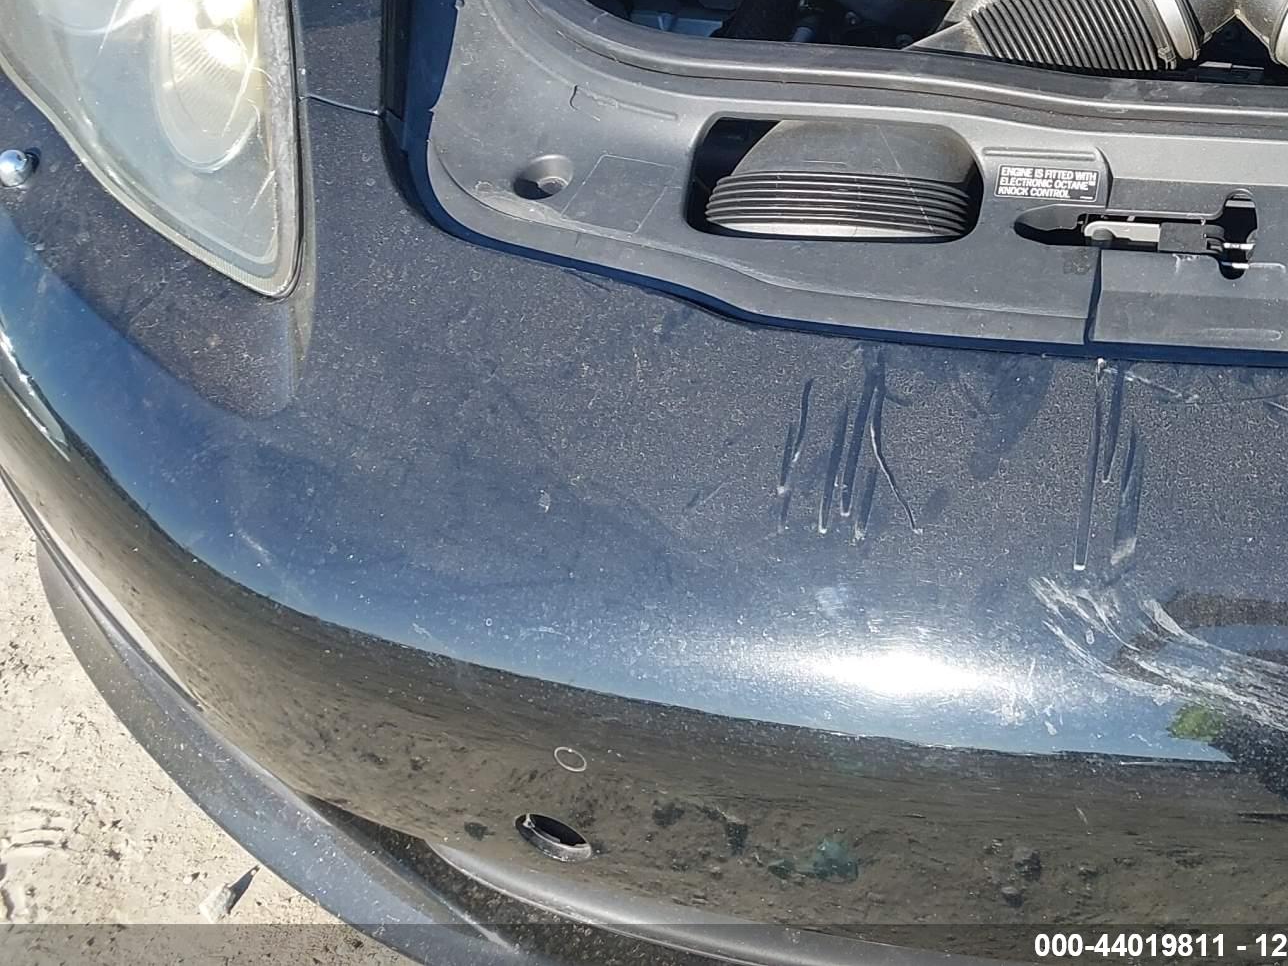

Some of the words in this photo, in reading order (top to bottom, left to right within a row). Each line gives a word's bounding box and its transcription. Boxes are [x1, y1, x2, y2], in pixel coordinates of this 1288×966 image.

[1001, 167, 1034, 178] ENGINE
[1034, 169, 1044, 178] IS
[1044, 169, 1074, 180] FITTED
[1074, 170, 1098, 181] WITH
[999, 177, 1053, 188] ELECTRONIC
[997, 186, 1029, 196] KNOCK
[1029, 188, 1071, 199] CONTROL
